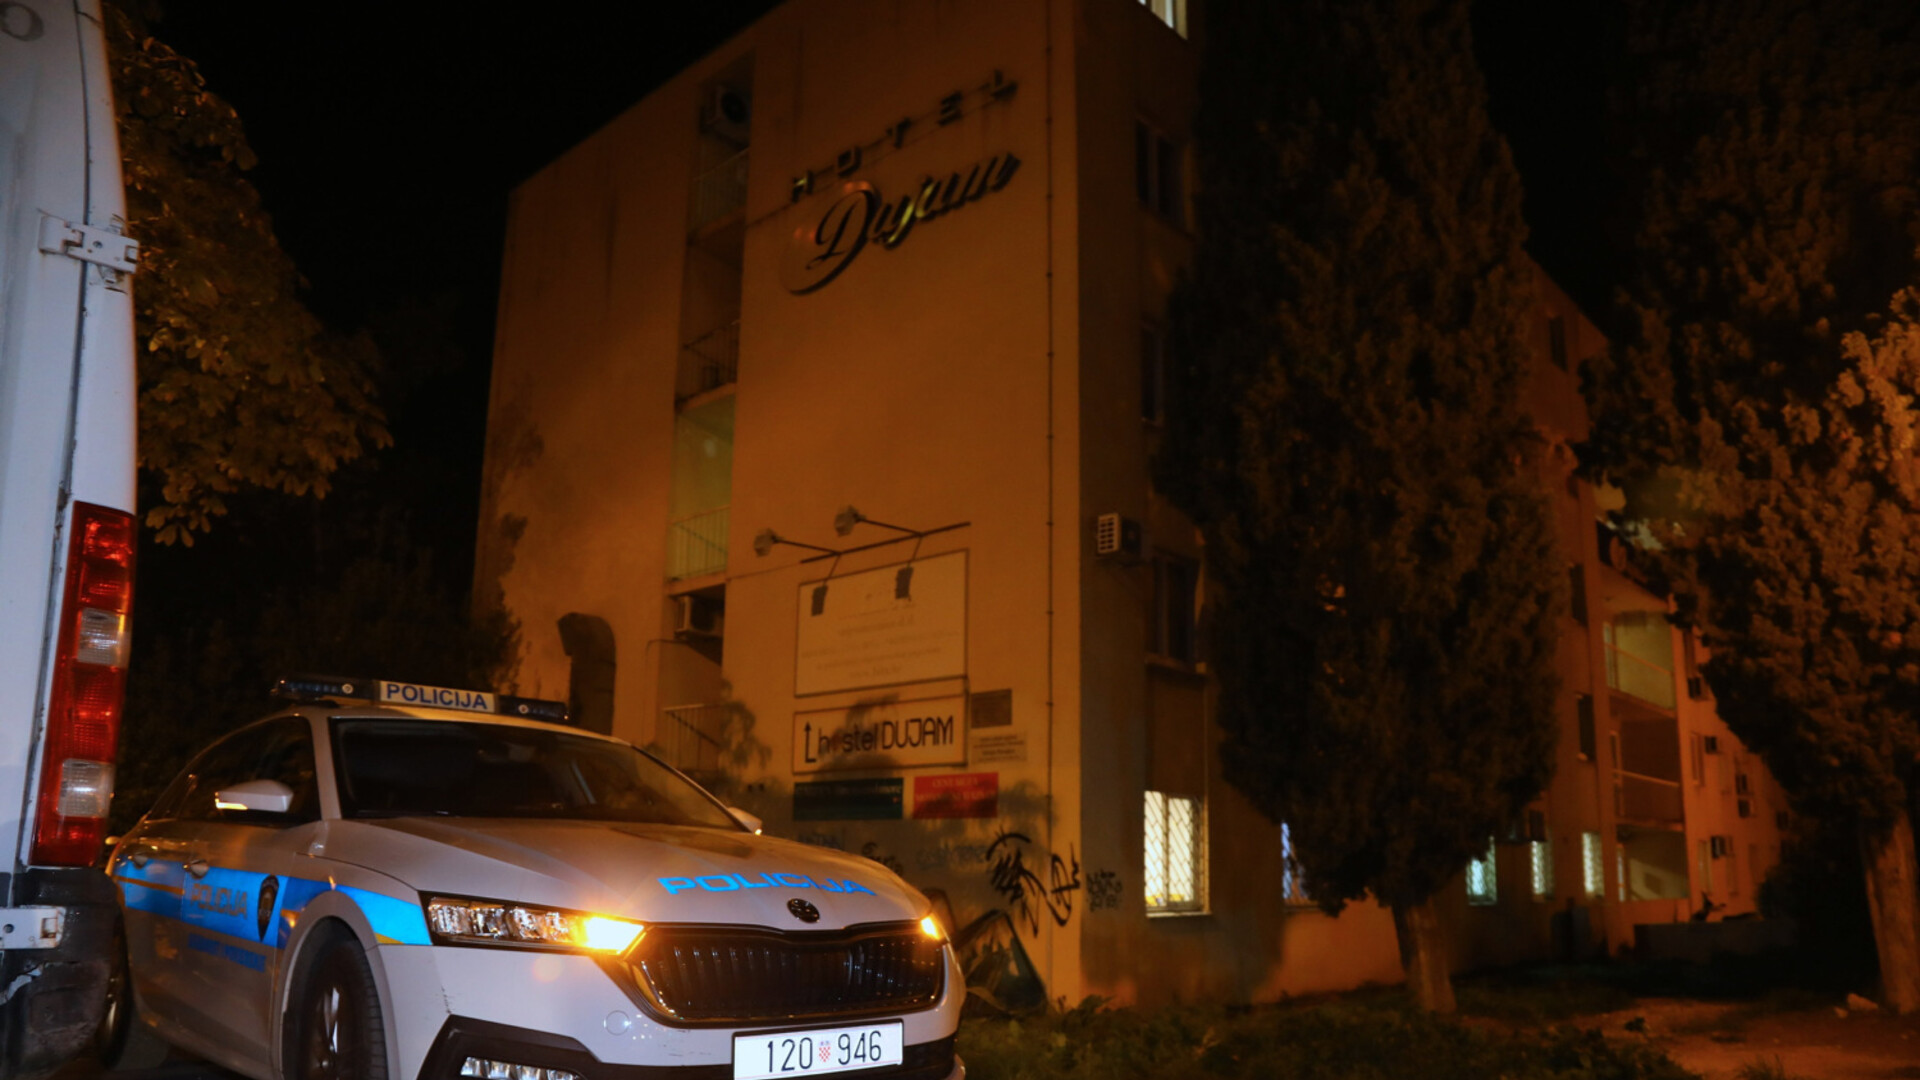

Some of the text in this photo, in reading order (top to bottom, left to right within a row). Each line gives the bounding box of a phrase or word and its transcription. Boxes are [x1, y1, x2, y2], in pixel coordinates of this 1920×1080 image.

[790, 69, 1019, 204] HOTEL
[386, 682, 488, 710] POLICIJA
[882, 715, 954, 750] DUJAM
[658, 872, 877, 896] POLICIJA
[767, 1030, 882, 1074] 120 946
